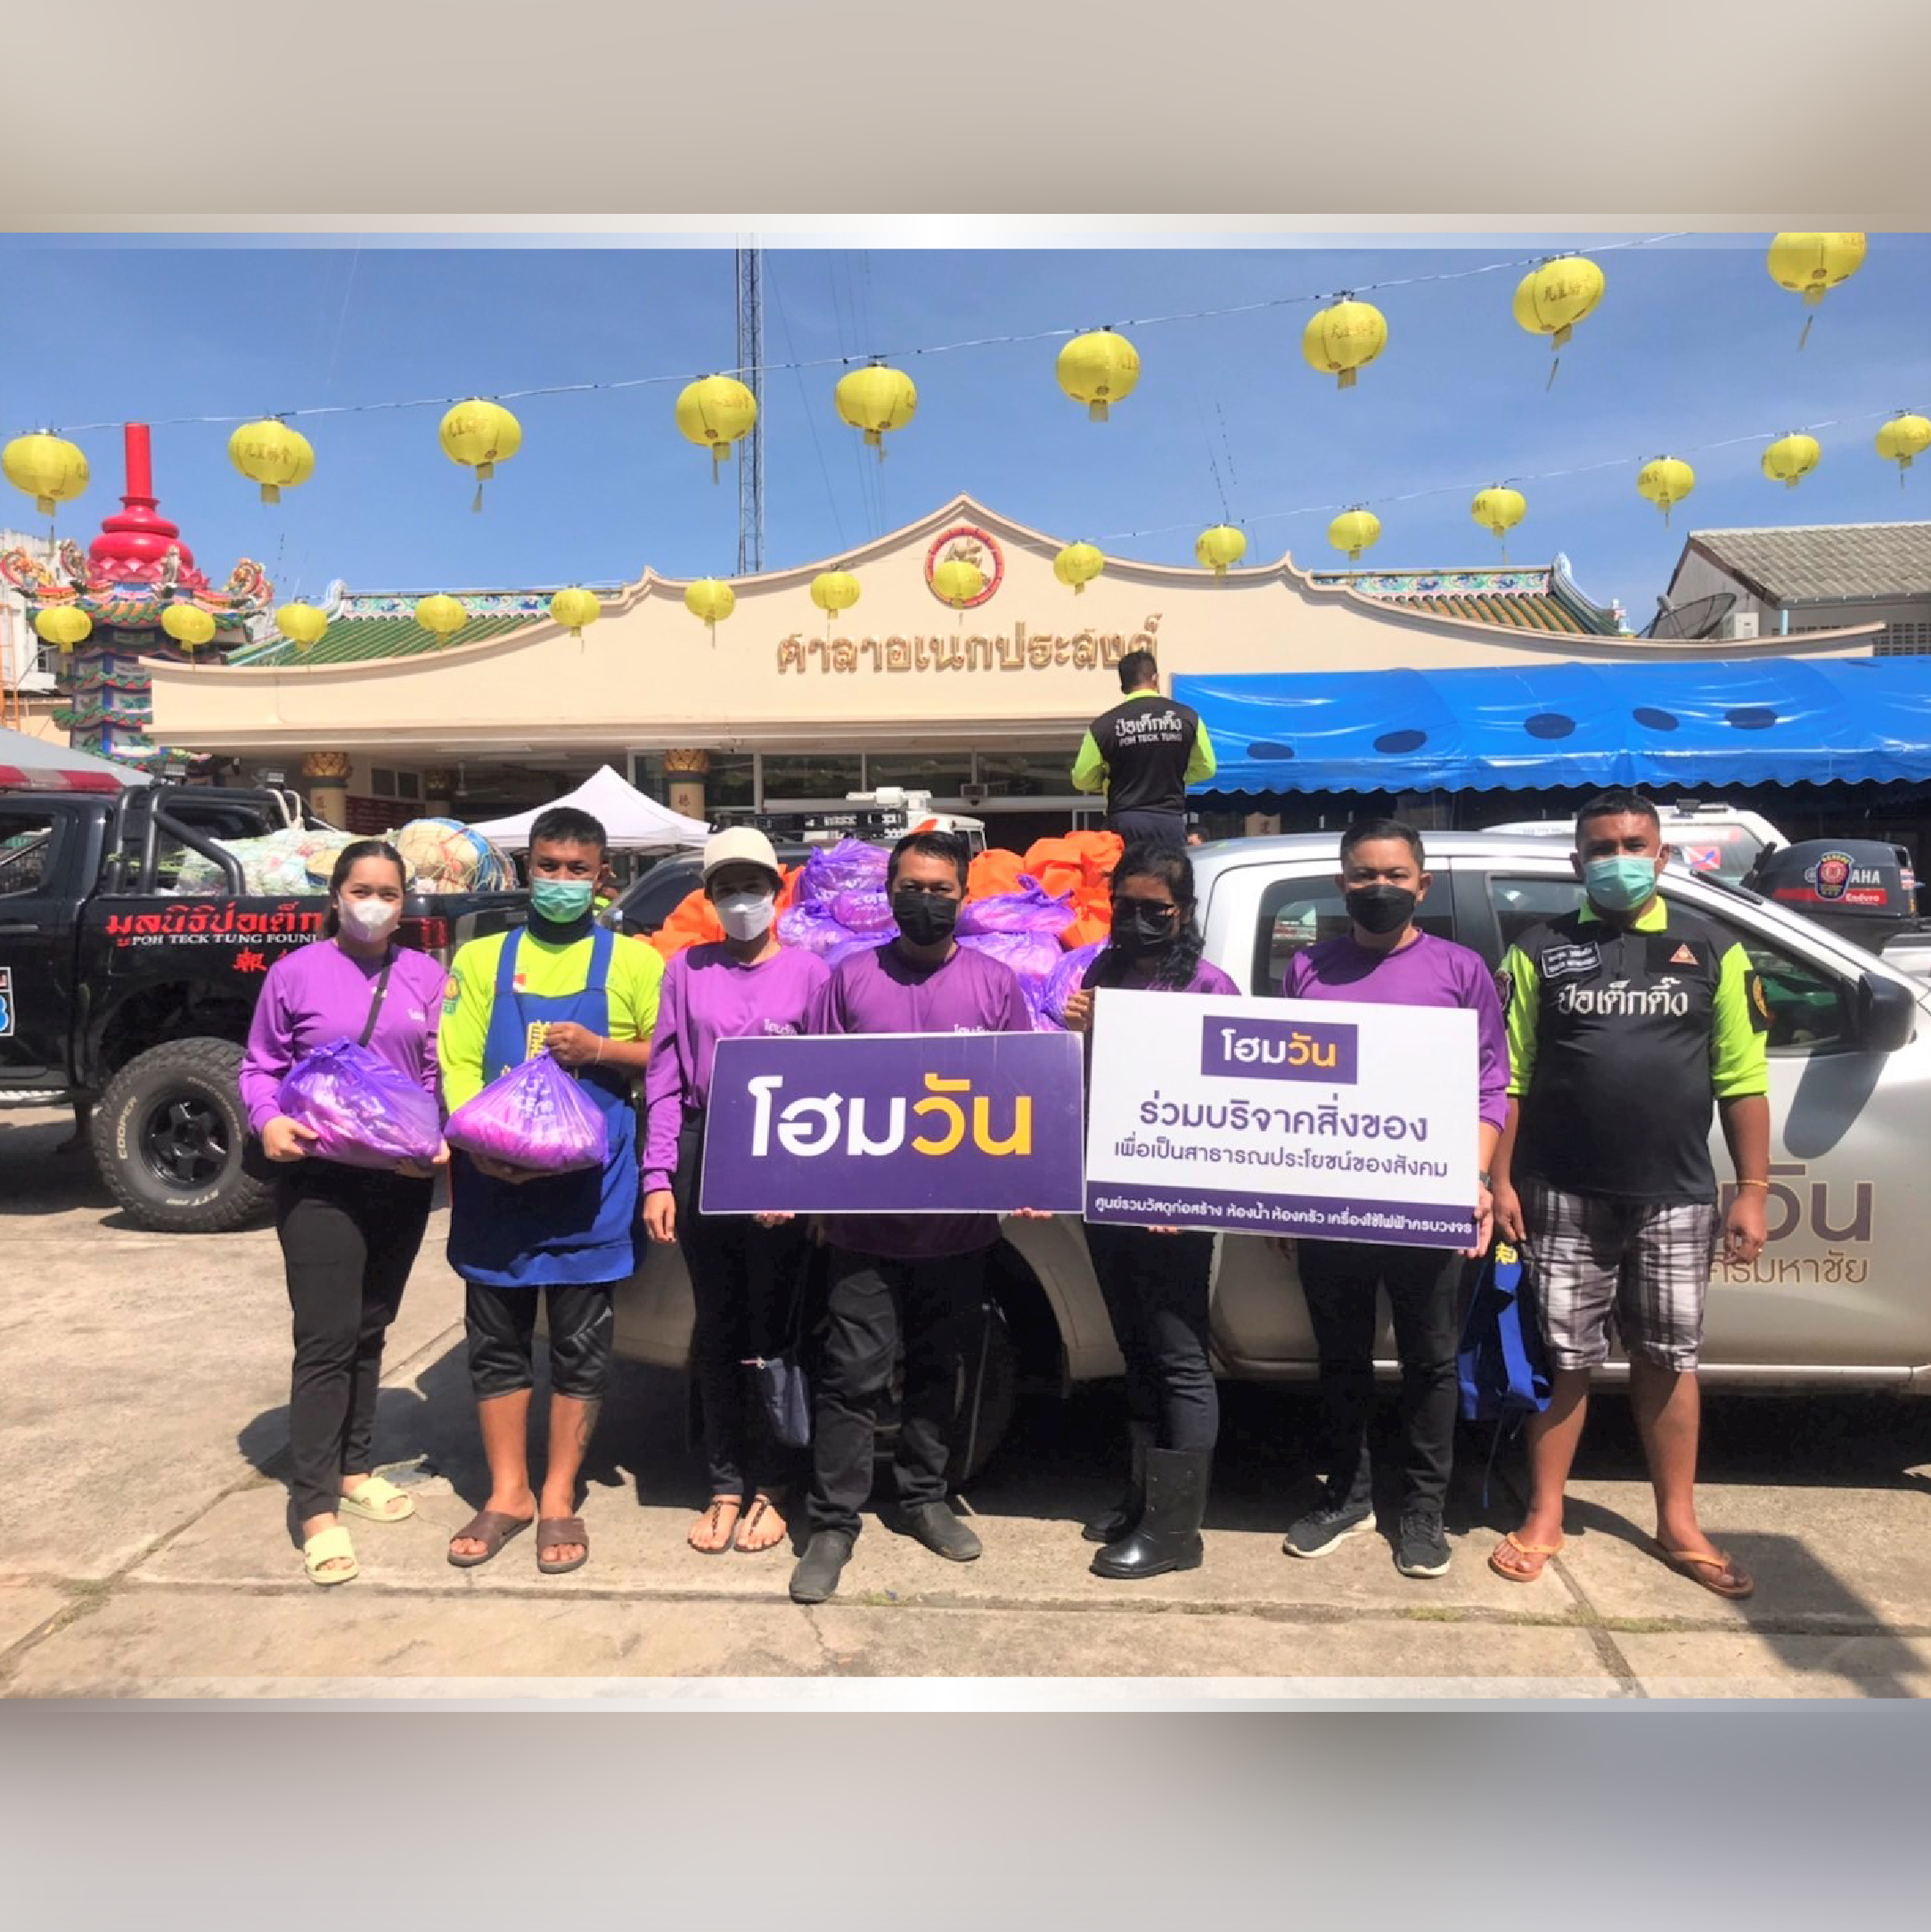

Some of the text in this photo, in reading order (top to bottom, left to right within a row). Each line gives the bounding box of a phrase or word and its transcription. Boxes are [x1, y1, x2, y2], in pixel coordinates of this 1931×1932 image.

[133, 933, 317, 946] POH TECK TUNG FOUN
[1559, 977, 1688, 1017] ป่อเต็กตึ๊ง
[1221, 1027, 1337, 1068] โฮมวัน
[748, 1071, 1033, 1157] โฮมวัน
[1140, 1090, 1428, 1142] ร่วมบริจาคสิ่งของ
[1114, 1131, 1448, 1178] เพื่อเป็นสาธารณประโยชน์ของสังคม
